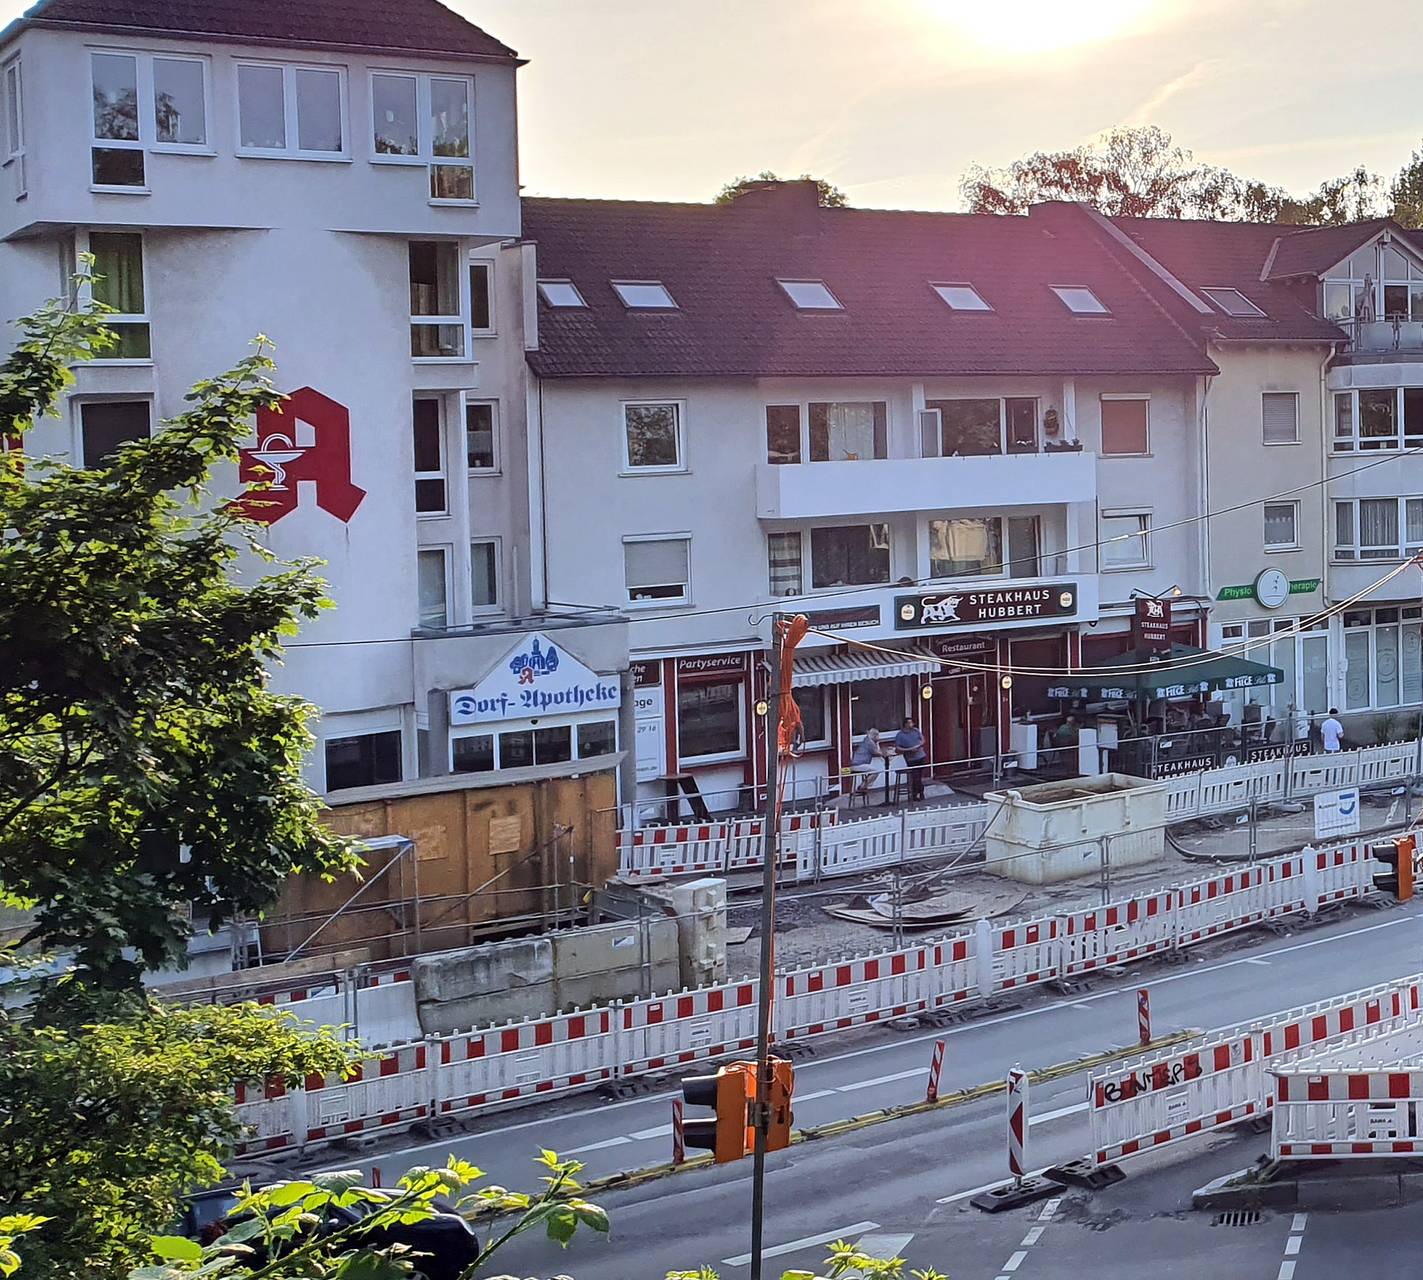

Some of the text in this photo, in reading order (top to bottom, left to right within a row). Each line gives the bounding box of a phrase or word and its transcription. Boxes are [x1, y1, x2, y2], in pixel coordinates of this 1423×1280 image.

[969, 589, 1051, 606] STEAKHAUS
[1224, 587, 1252, 598] Physio
[978, 604, 1042, 619] HUBBERT
[941, 641, 985, 653] Restaurant
[680, 655, 741, 670] Partyservice
[520, 682, 618, 712] Apotheke
[1157, 756, 1212, 774] TEAKHAUS
